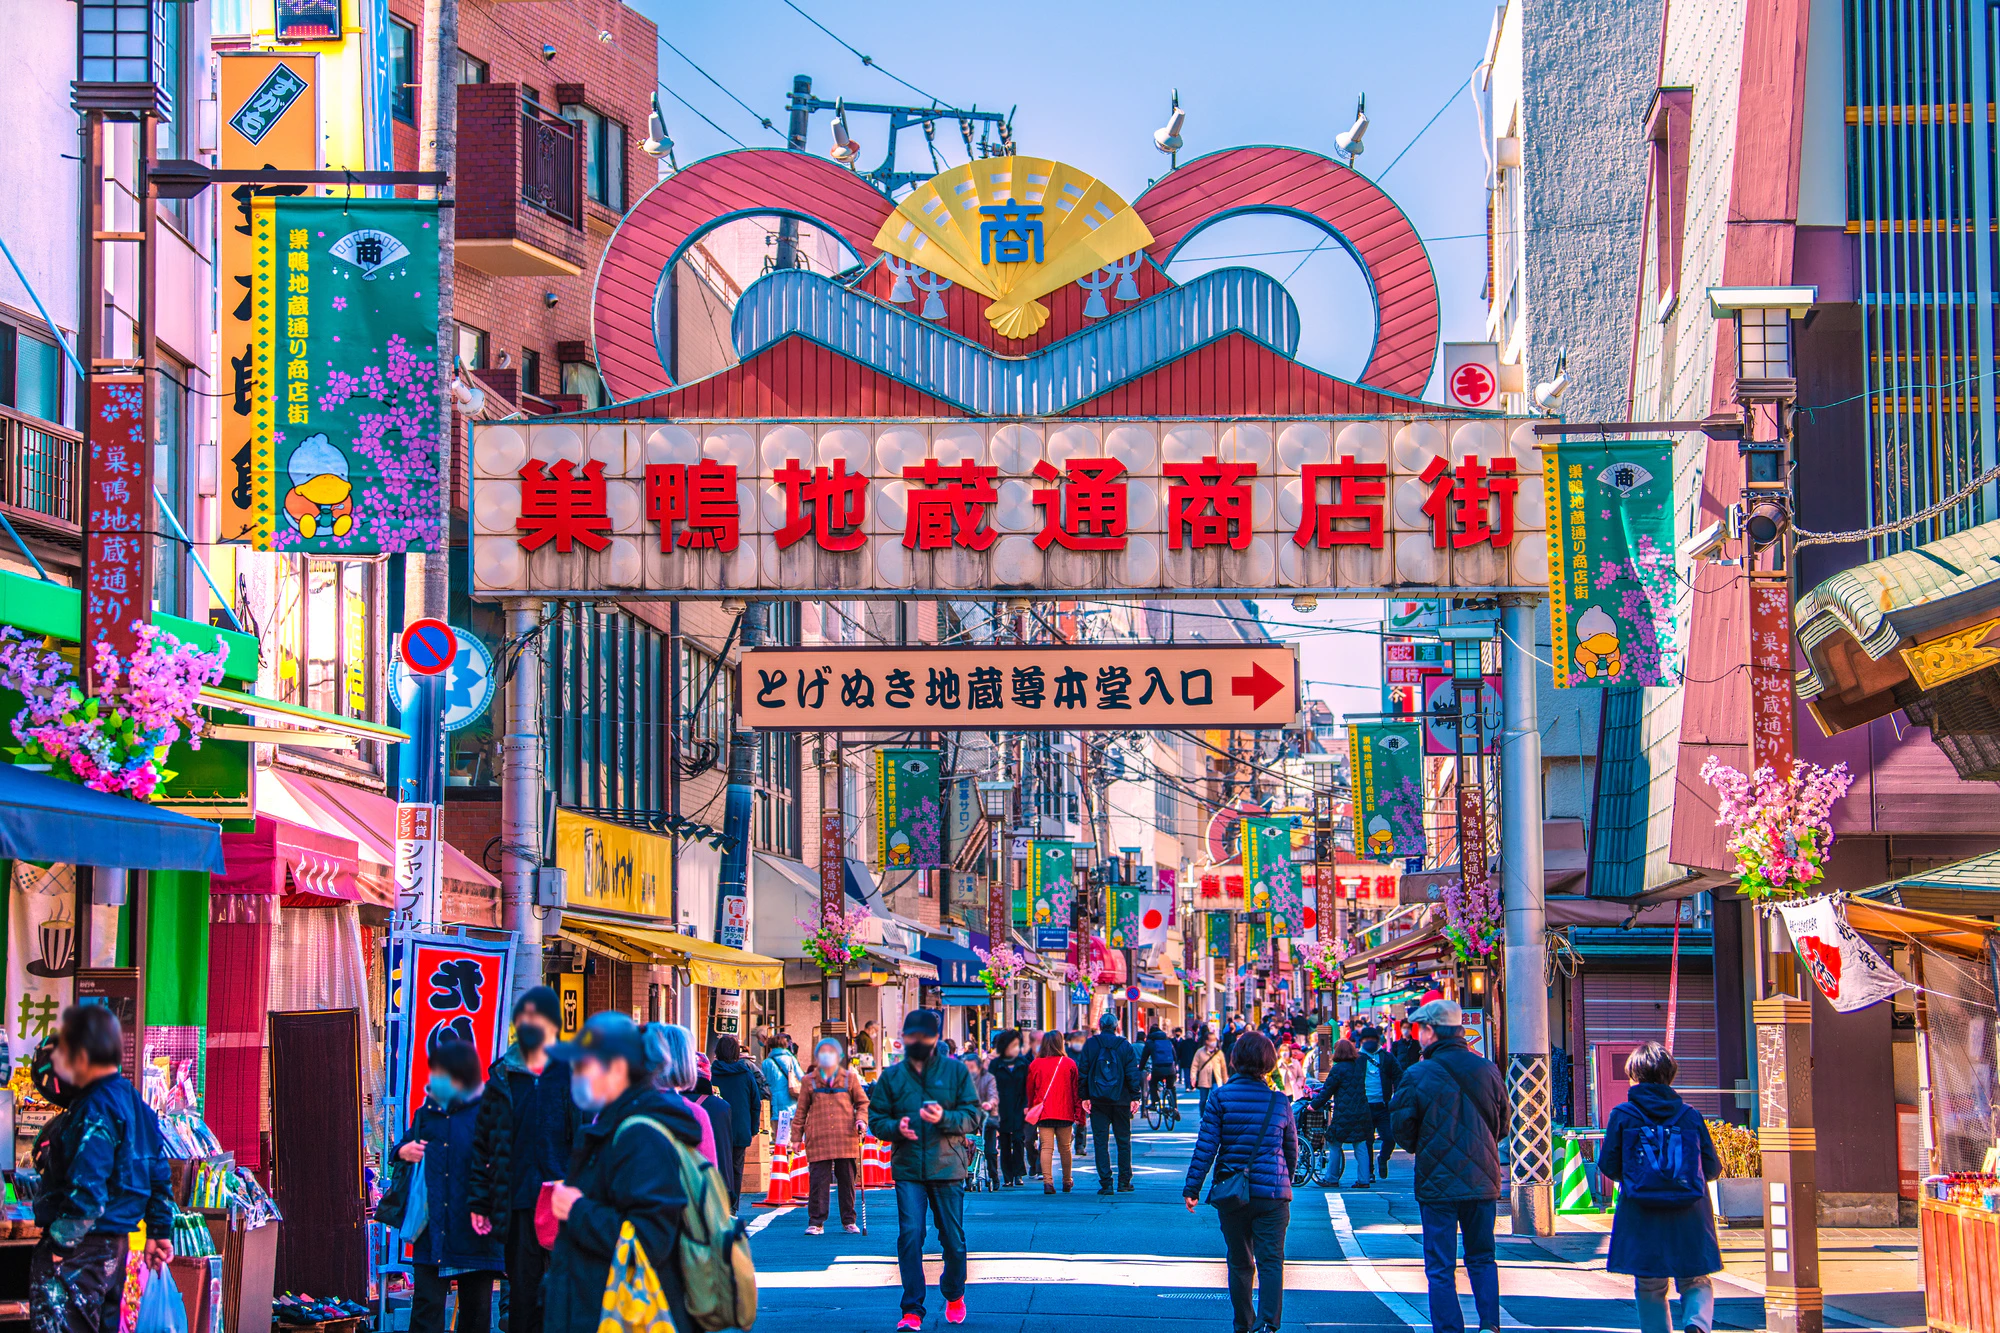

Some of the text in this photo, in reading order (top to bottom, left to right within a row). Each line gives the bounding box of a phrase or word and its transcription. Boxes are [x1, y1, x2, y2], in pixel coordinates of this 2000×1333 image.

[241, 75, 298, 136] すがも
[356, 239, 383, 266] 商
[978, 197, 1045, 265] 商
[287, 228, 310, 425] 巣鴨地蔵通り商店街
[516, 455, 1518, 553] 巣鴨地蔵通商店街
[1614, 467, 1635, 488] 商
[100, 446, 131, 625] 巣鴨地蔵通り
[1567, 463, 1590, 601] 巣鴨地蔵通り商店街
[1390, 669, 1422, 683] 銀行
[1421, 645, 1436, 660] 酒
[757, 665, 1213, 710] とげぬき地蔵尊本堂入口
[1759, 631, 1782, 757] 巣鴨地蔵通り
[826, 838, 837, 900] 巣鴨地蔵通り
[1466, 816, 1479, 886] 巣鴨地蔵通り
